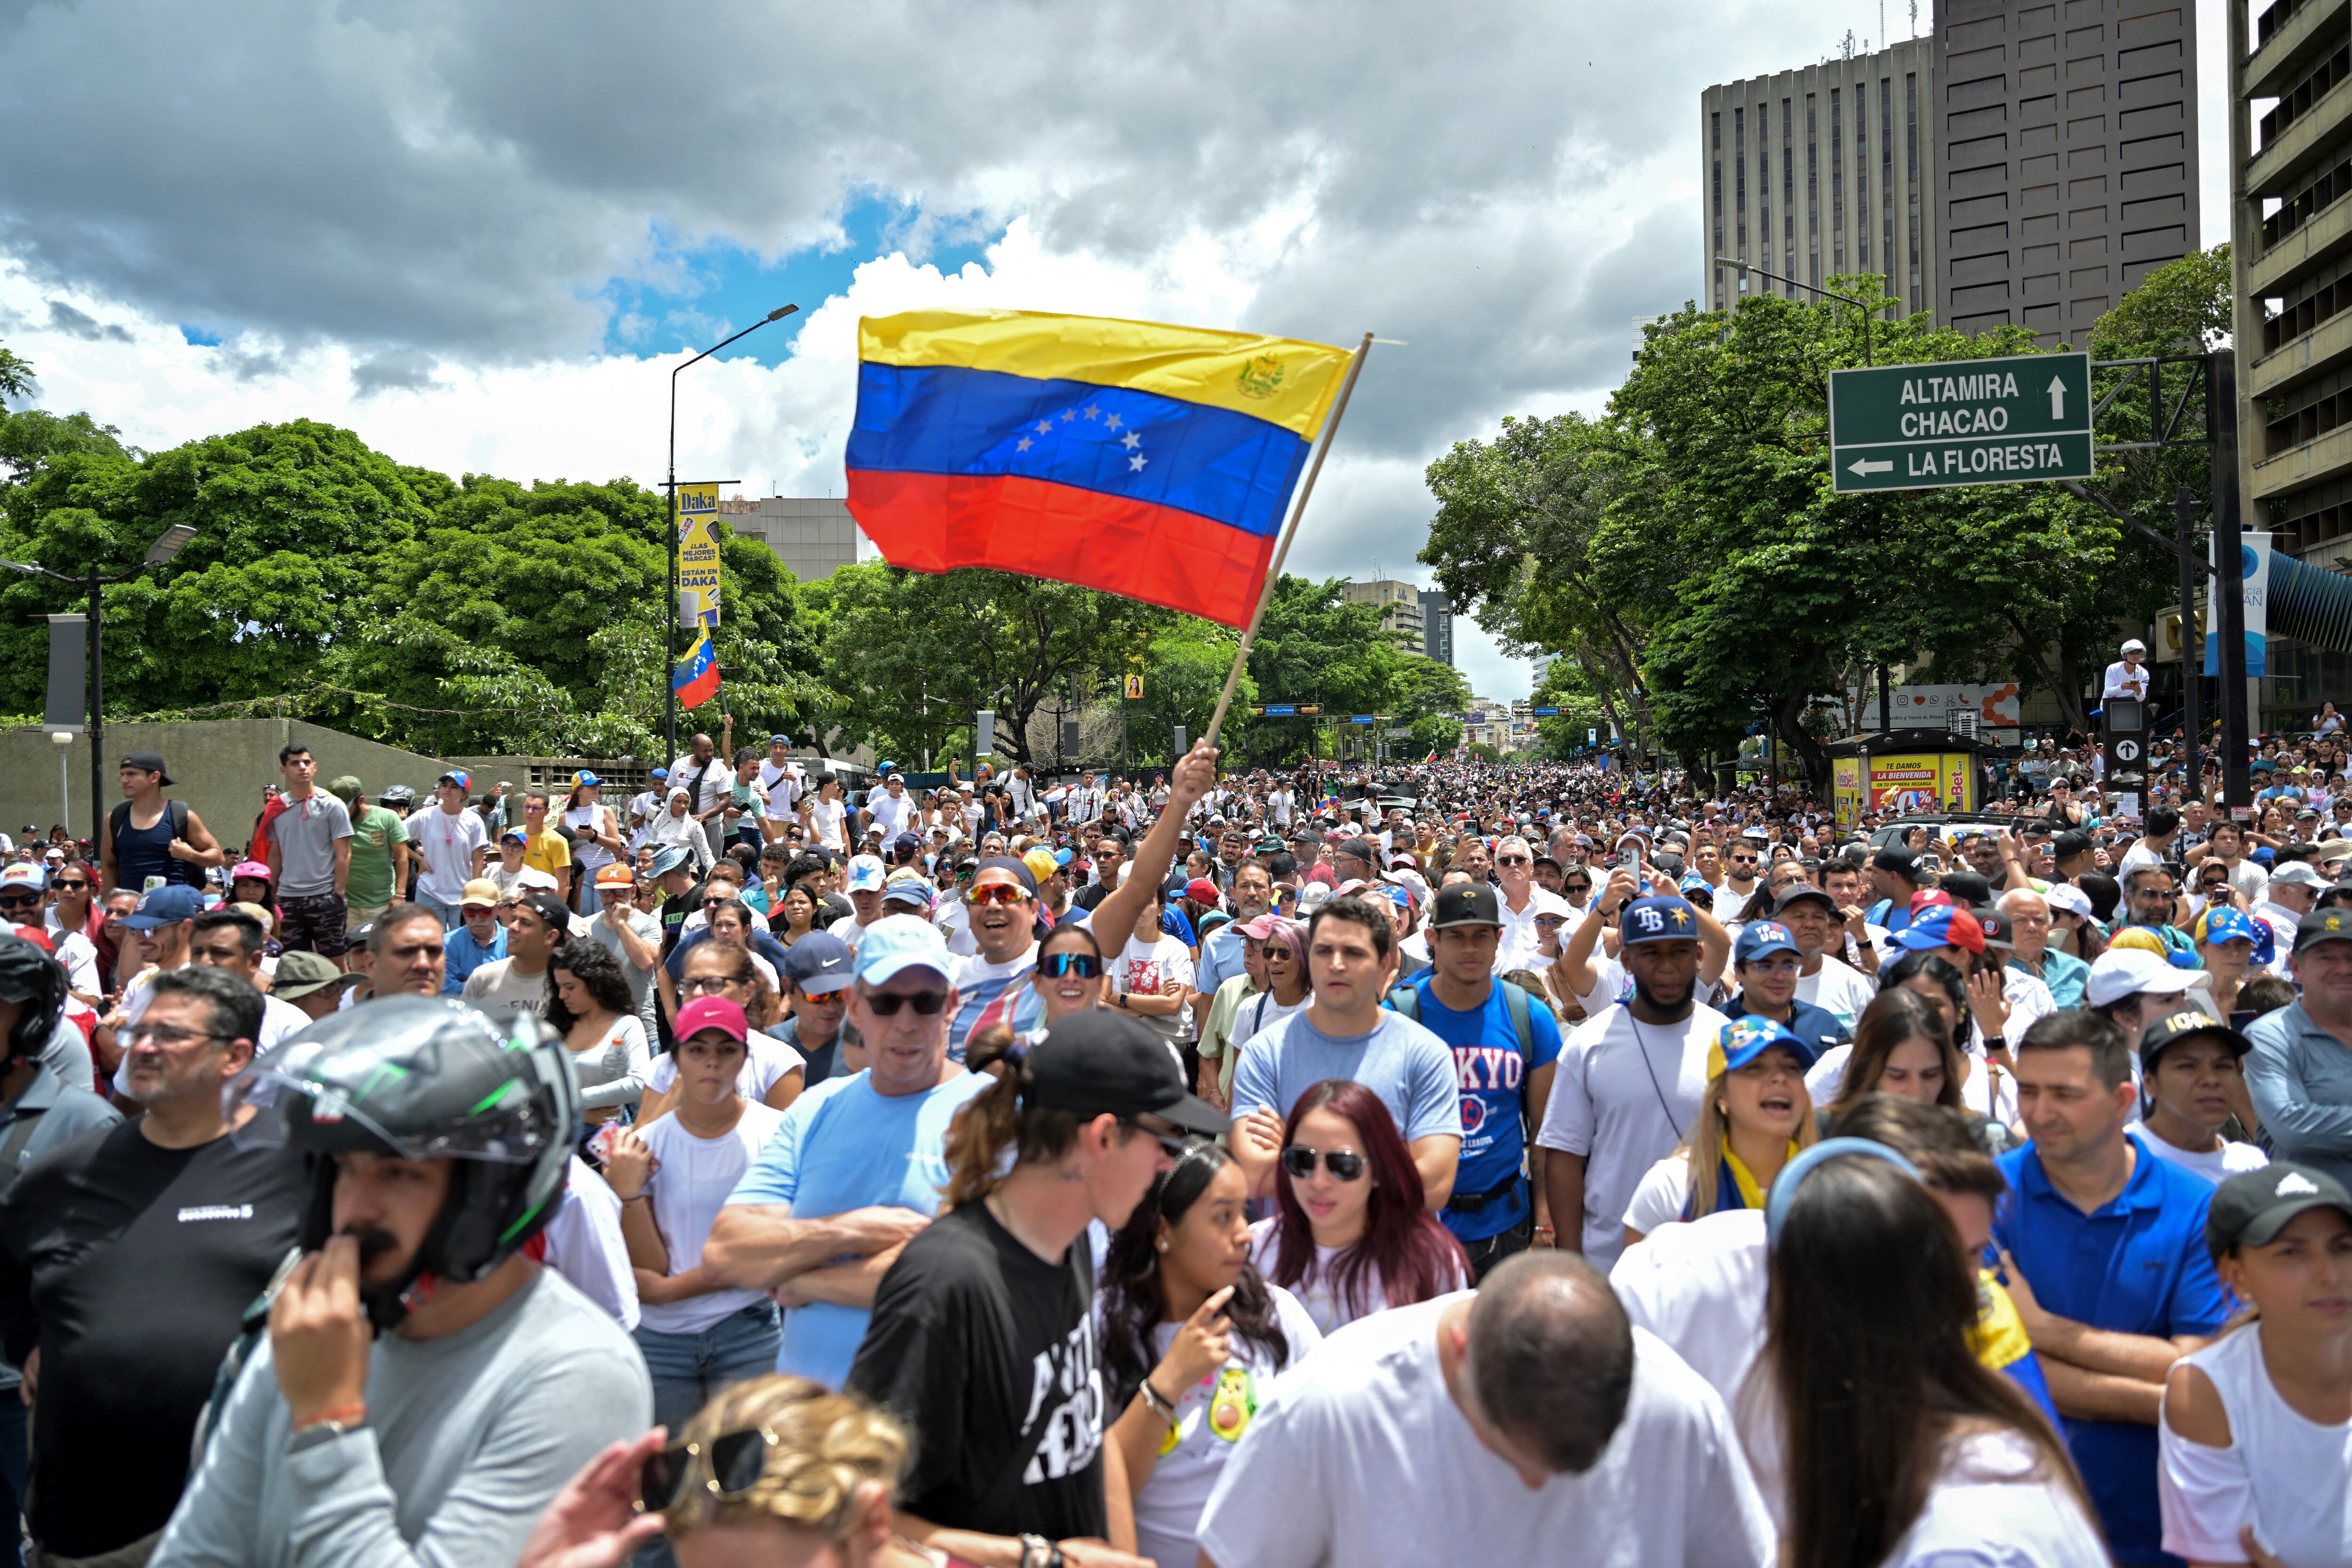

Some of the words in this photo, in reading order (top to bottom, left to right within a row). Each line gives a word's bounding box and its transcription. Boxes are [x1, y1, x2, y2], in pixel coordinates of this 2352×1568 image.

[1900, 372, 2019, 405] ALTAMIRA
[1901, 406, 2008, 437] CHACAO
[1908, 452, 1937, 476] LA
[1944, 444, 2064, 474] FLORESTA
[682, 492, 715, 510] Daka
[682, 576, 717, 587] DAKA
[1755, 924, 1770, 934] YO
[1760, 929, 1785, 942] UCV
